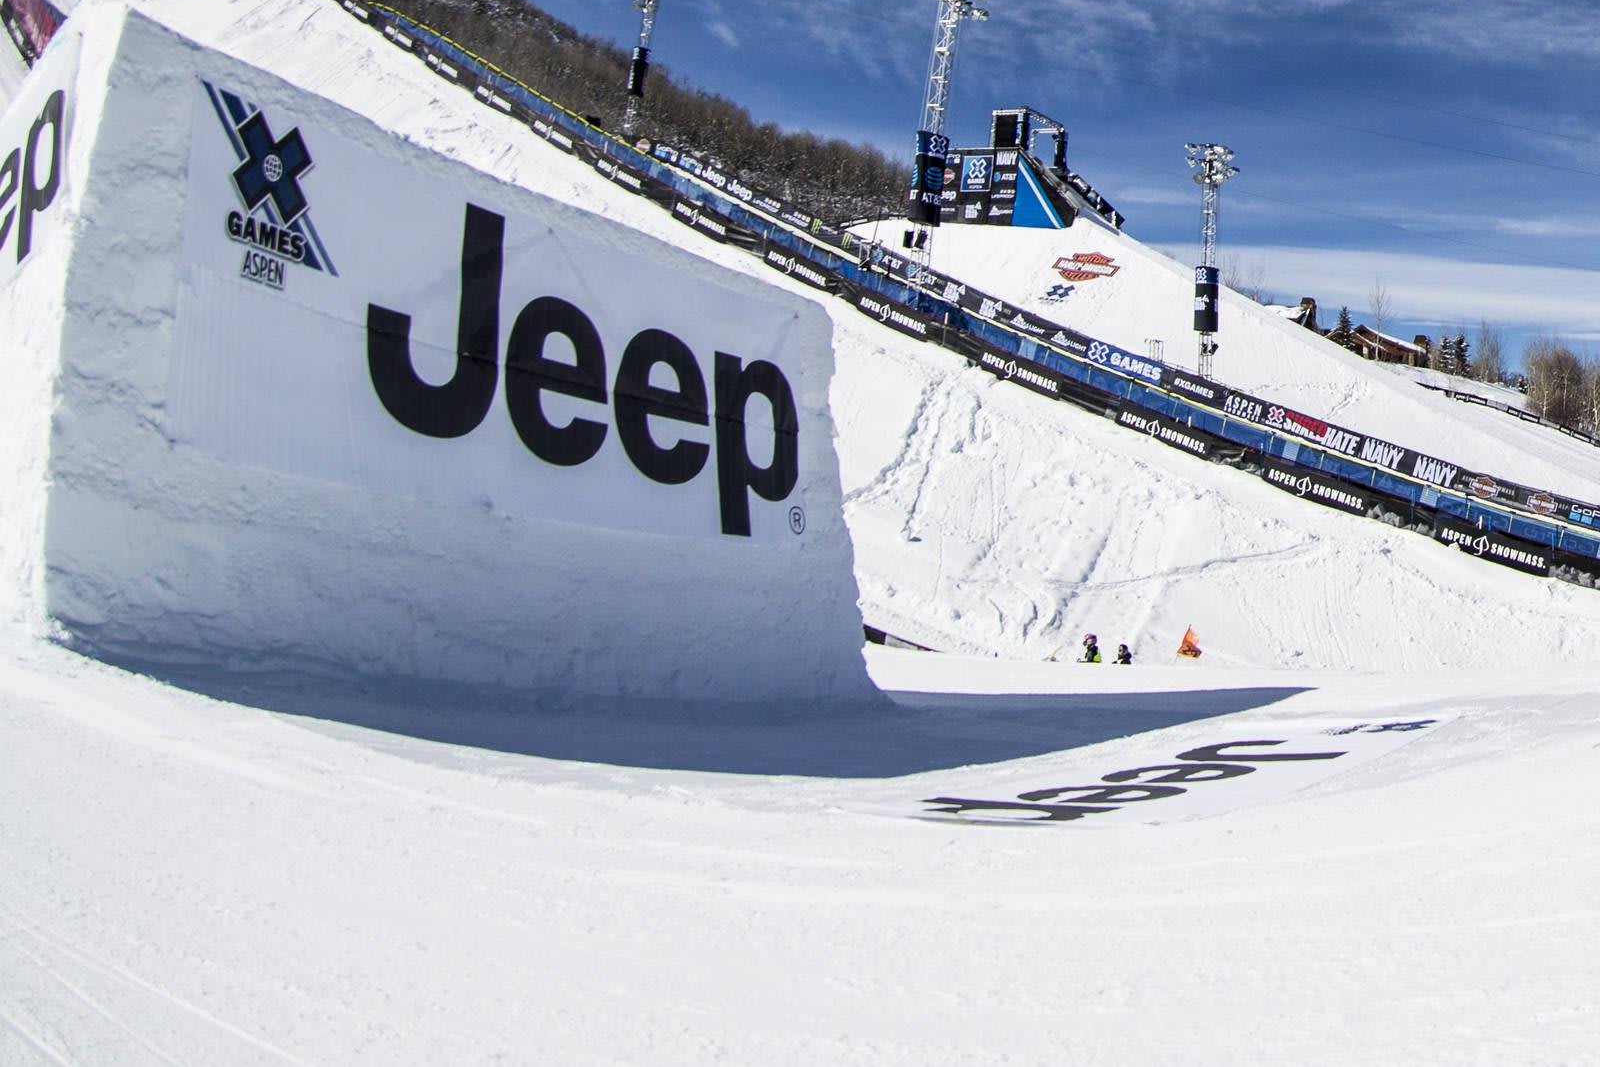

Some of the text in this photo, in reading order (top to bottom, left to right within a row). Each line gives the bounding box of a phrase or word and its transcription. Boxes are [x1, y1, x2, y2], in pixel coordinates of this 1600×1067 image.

[996, 151, 1018, 166] NAVY
[702, 166, 726, 187] Jeep
[1001, 173, 1017, 181] AT&T
[727, 179, 753, 201] Jeep
[227, 211, 306, 262] GAMES
[242, 250, 285, 287] ASPEN
[767, 250, 786, 266] ASPEN
[881, 255, 903, 270] AT&T
[860, 296, 880, 313] ASPEN
[367, 203, 798, 536] Jeep
[982, 352, 1005, 369] ASPEN
[1110, 352, 1162, 381] GAMES
[1174, 377, 1214, 399] #XGAMES
[1224, 395, 1262, 417] ASPEN
[1120, 411, 1146, 431] ASPEN
[1321, 427, 1360, 455] HATE
[1361, 438, 1405, 470] NAVY
[1268, 468, 1297, 488] ASPEN
[1412, 455, 1457, 488] NAVY
[1441, 528, 1472, 548] ASPEN
